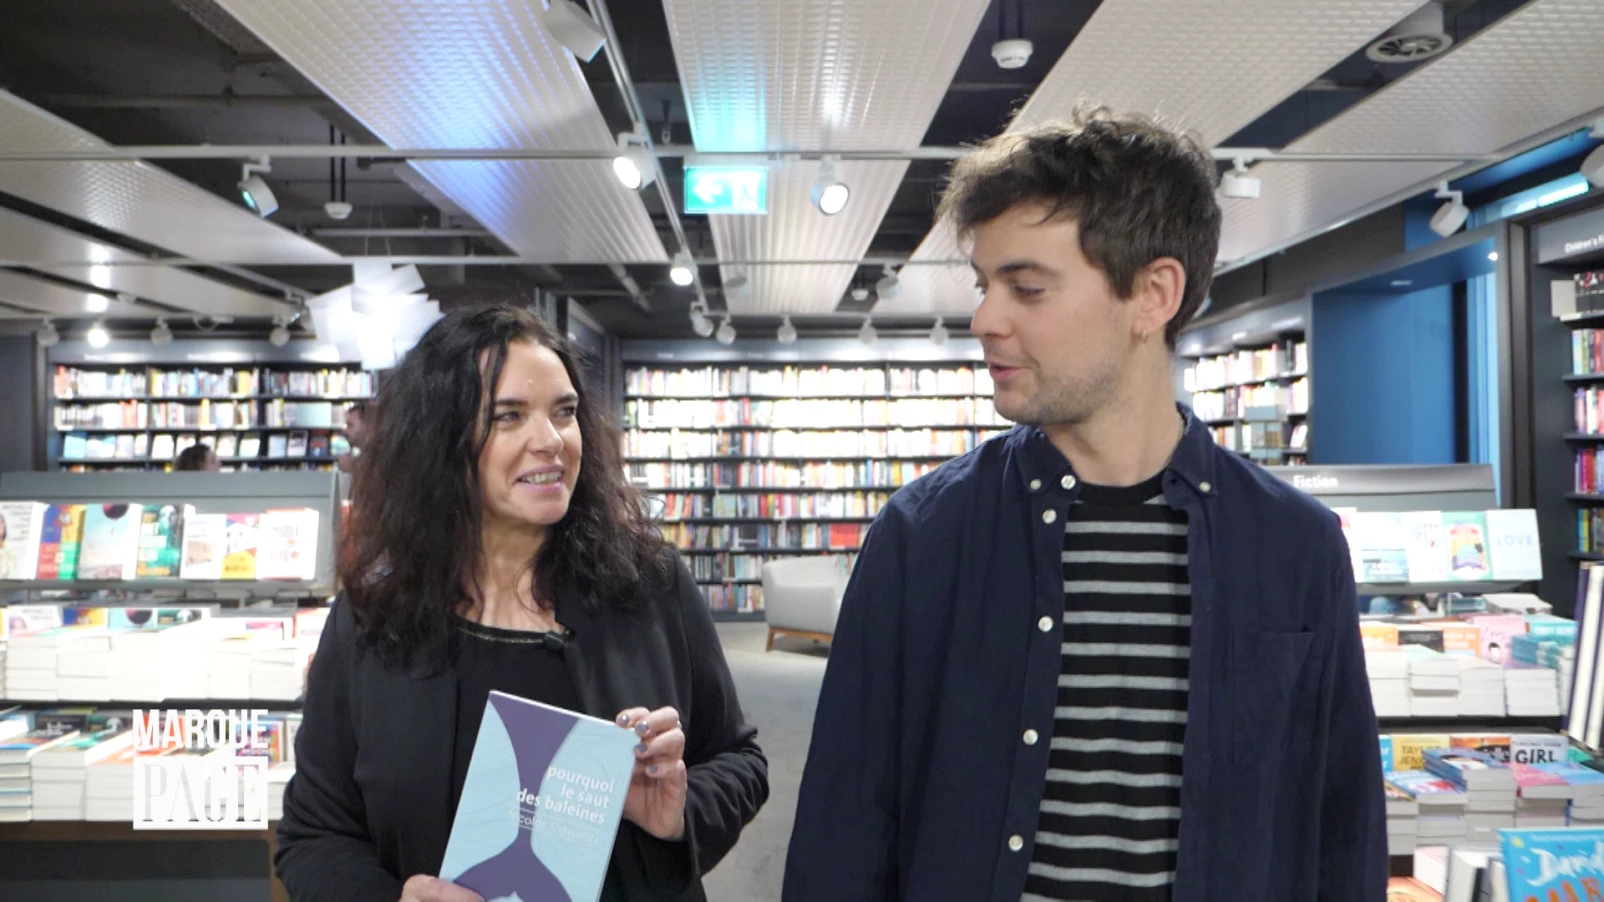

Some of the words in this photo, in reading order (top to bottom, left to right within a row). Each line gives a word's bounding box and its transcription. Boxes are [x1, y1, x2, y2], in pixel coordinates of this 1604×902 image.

[1293, 475, 1338, 488] Fiction
[1497, 535, 1533, 546] LOVE
[1515, 749, 1558, 764] GIRL
[546, 767, 615, 793] pourquoi
[561, 783, 574, 799] le
[579, 791, 610, 808] saut
[516, 788, 540, 807] des
[545, 796, 605, 824] baleines
